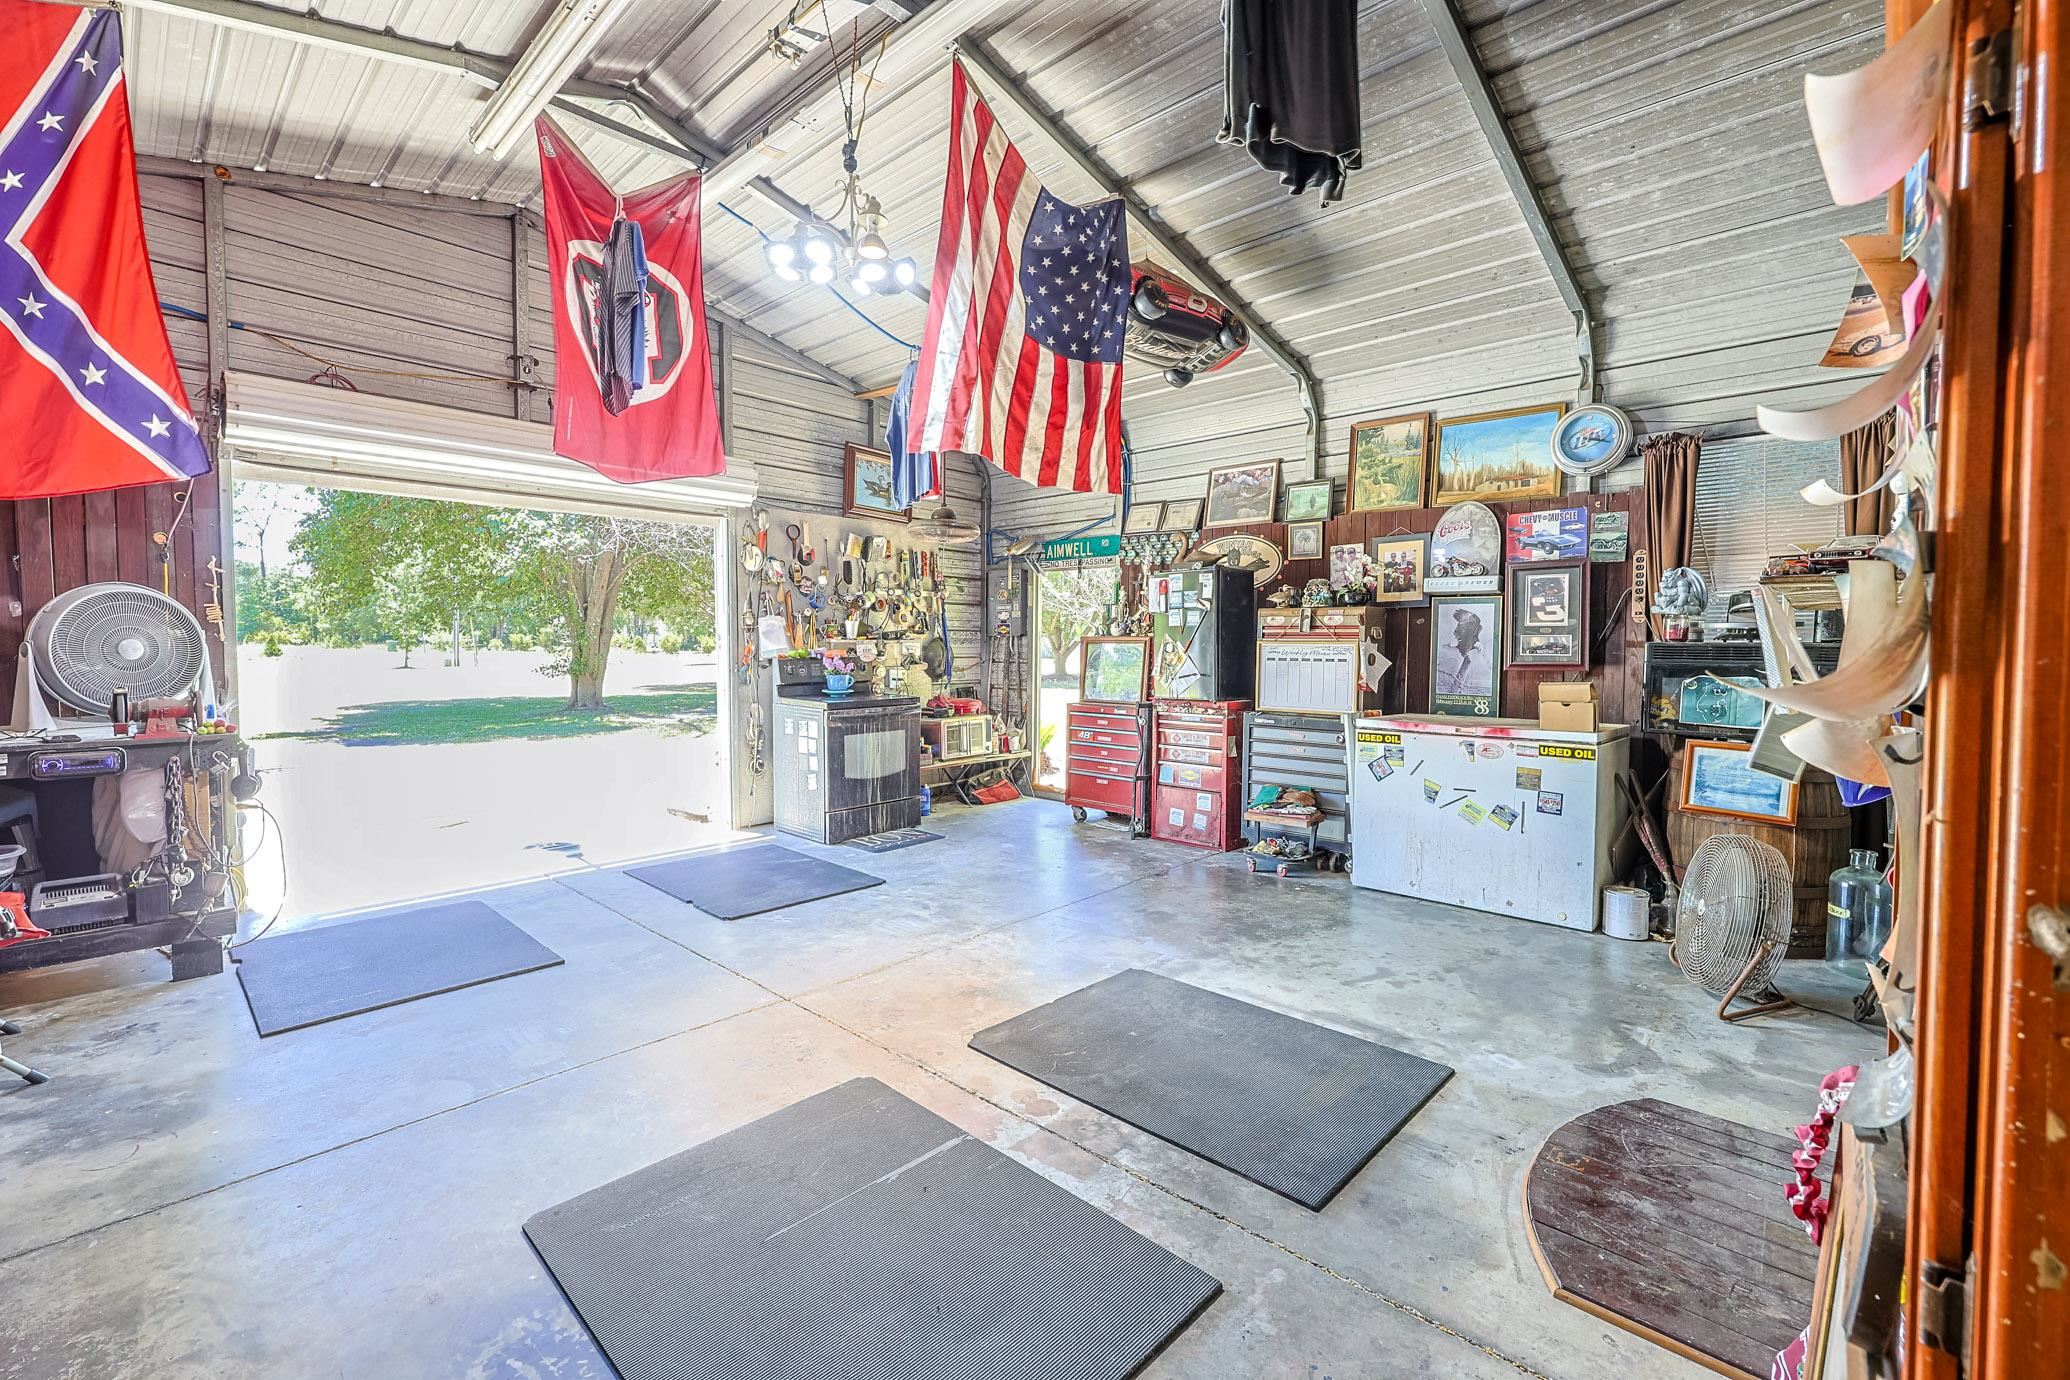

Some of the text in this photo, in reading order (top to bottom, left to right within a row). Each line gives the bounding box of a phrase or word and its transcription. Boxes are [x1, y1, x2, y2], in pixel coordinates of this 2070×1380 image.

[1519, 510, 1578, 525] CHEVY MUSCLE
[1439, 520, 1473, 538] Coors
[1046, 538, 1110, 559] AIMWELL RD
[1050, 560, 1060, 568] NO
[1358, 733, 1401, 744] USED OIL
[1540, 746, 1572, 757] USED
[1574, 749, 1595, 759] OIL
